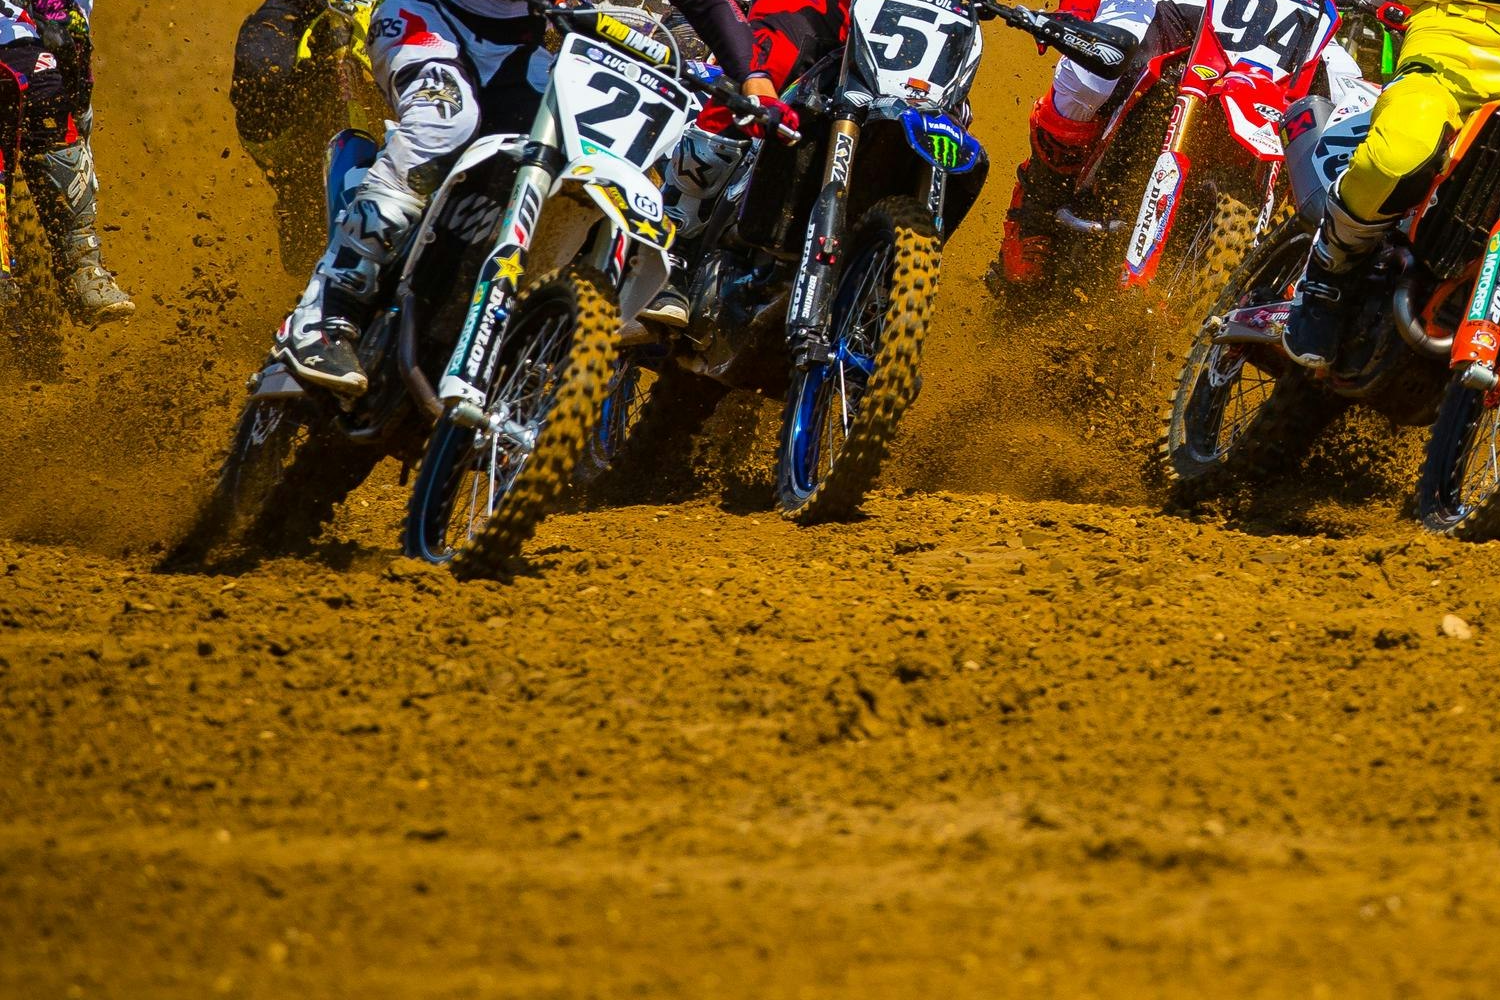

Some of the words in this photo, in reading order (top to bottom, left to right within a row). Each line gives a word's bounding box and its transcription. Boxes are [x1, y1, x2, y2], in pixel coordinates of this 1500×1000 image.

[640, 73, 660, 89] OIL
[574, 70, 675, 168] 21
[1136, 187, 1162, 258] DUNLOP
[1468, 252, 1500, 318] MOTOREX
